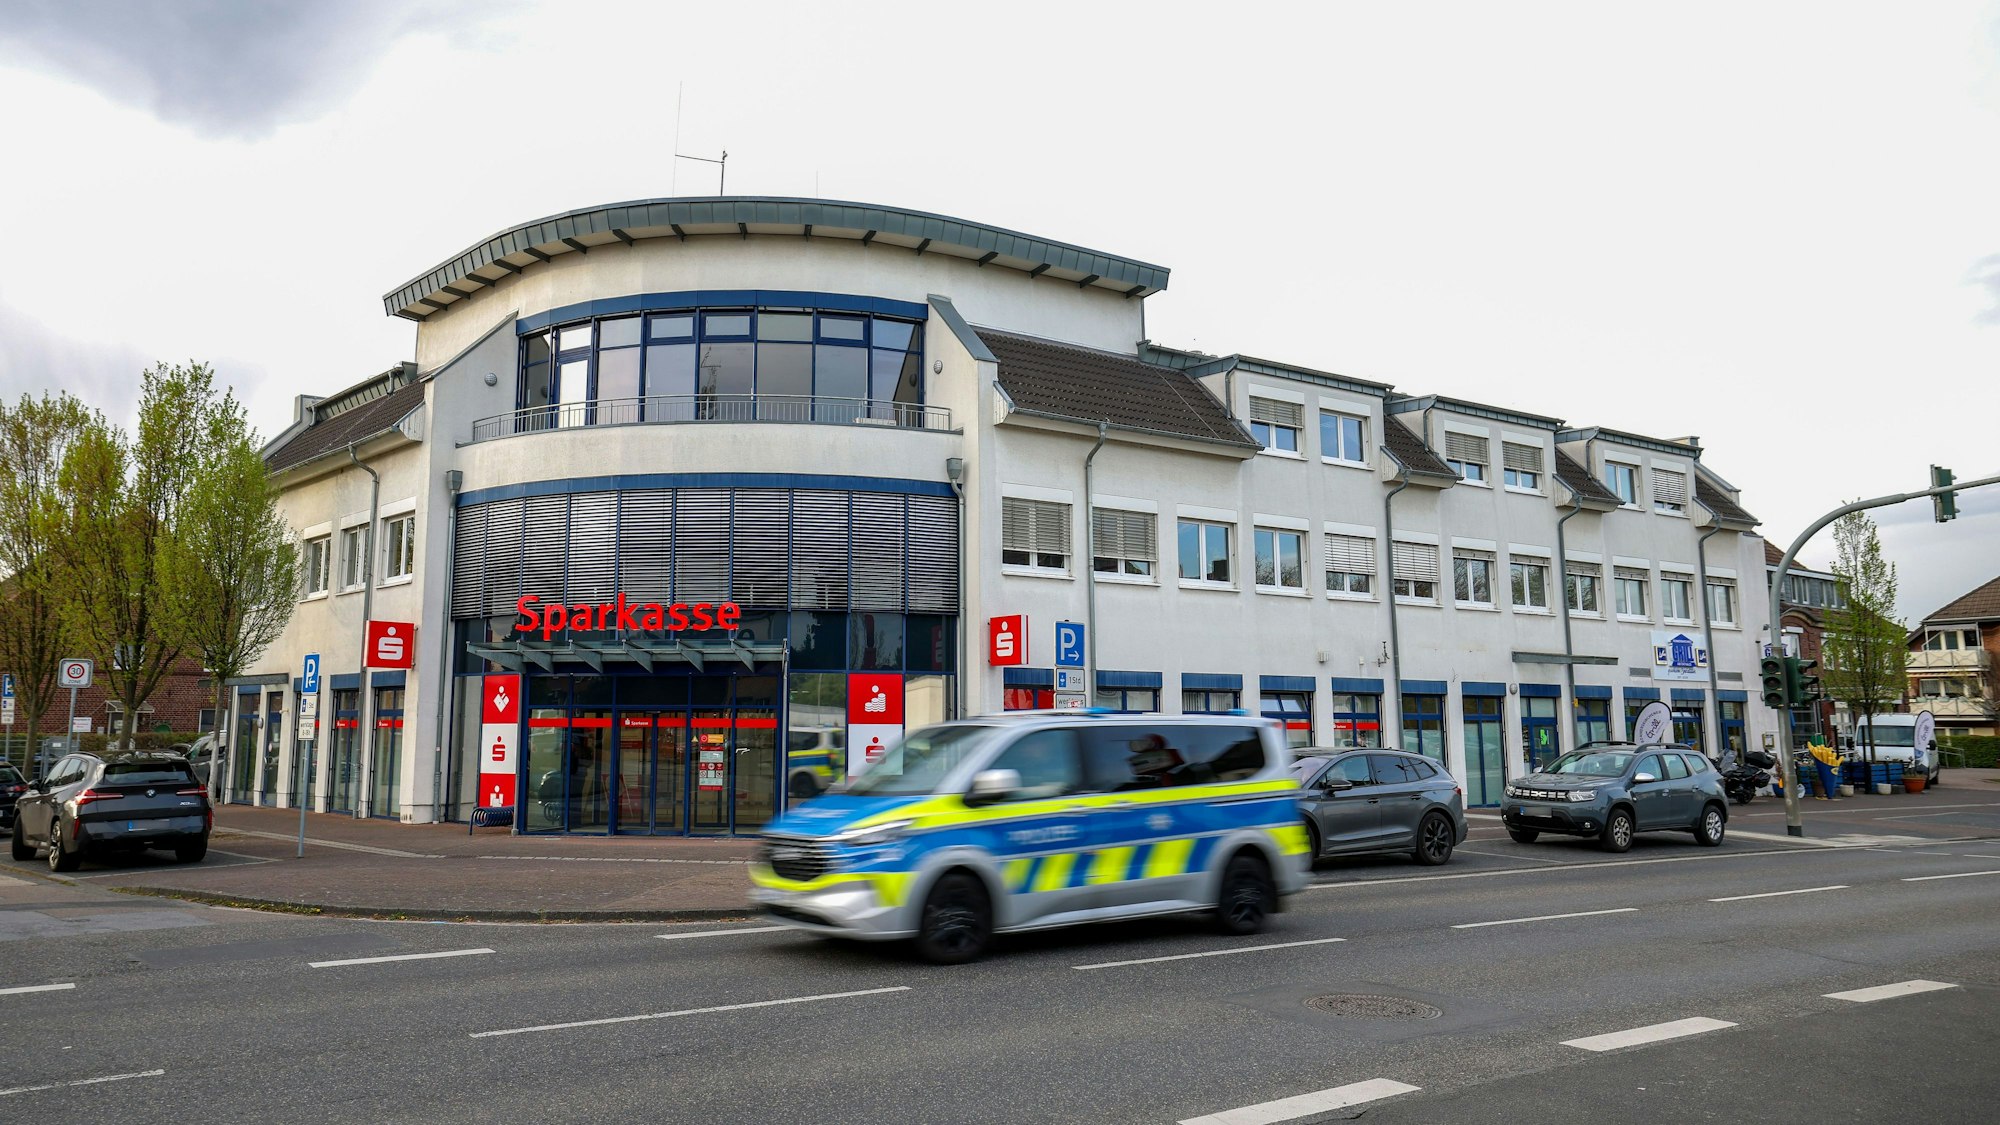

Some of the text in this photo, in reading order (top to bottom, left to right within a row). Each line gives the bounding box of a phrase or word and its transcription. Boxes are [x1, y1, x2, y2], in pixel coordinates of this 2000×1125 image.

[515, 592, 741, 641] Sparkasse
[1060, 627, 1076, 660] P
[70, 667, 81, 675] 30
[305, 659, 316, 688] P
[1645, 718, 1661, 739] Grill
